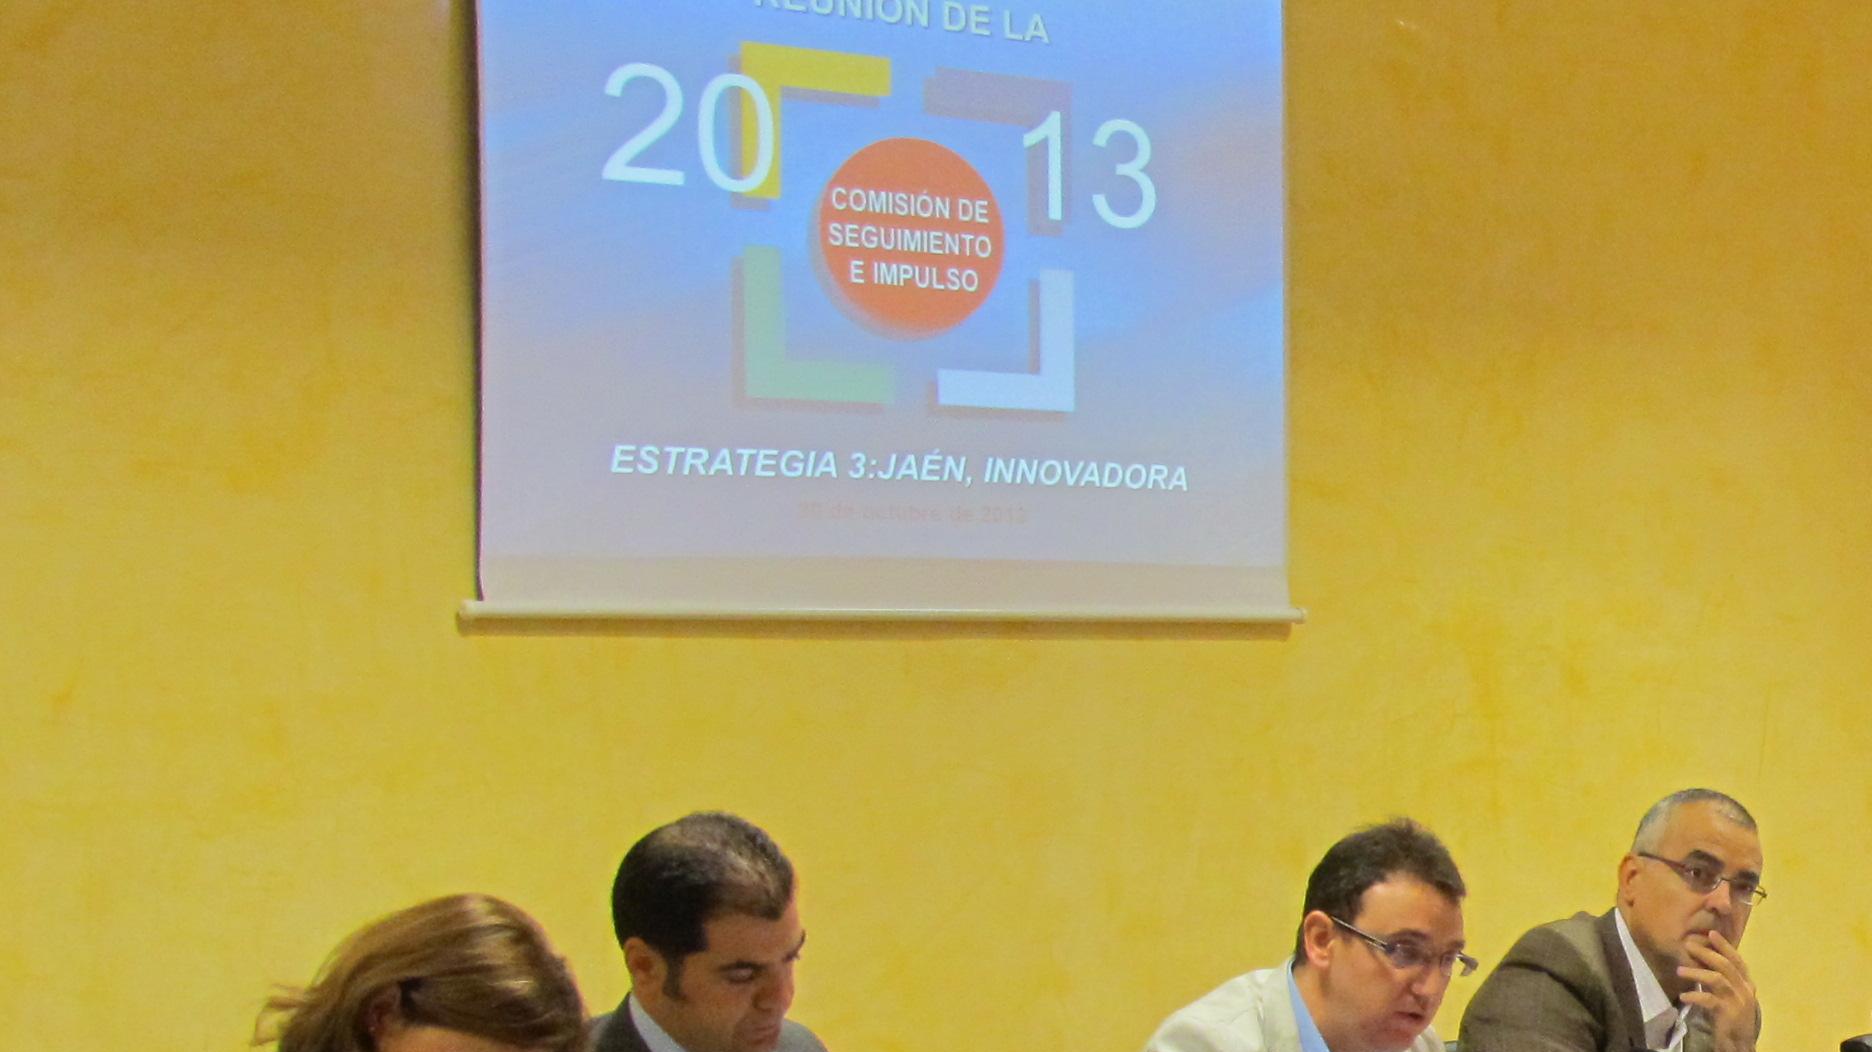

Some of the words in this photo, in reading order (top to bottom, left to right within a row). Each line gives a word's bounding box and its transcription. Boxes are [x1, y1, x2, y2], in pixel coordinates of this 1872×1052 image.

[943, 4, 992, 36] DE
[1003, 11, 1050, 43] LA
[831, 187, 950, 219] COMISIÓN
[958, 198, 990, 224] DE
[828, 222, 992, 258] SEGUIMIENTO
[850, 260, 865, 284] E
[874, 262, 979, 292] IMPULSO
[610, 445, 838, 478] ESTRATEGIA
[983, 456, 1189, 491] INNOVADORA
